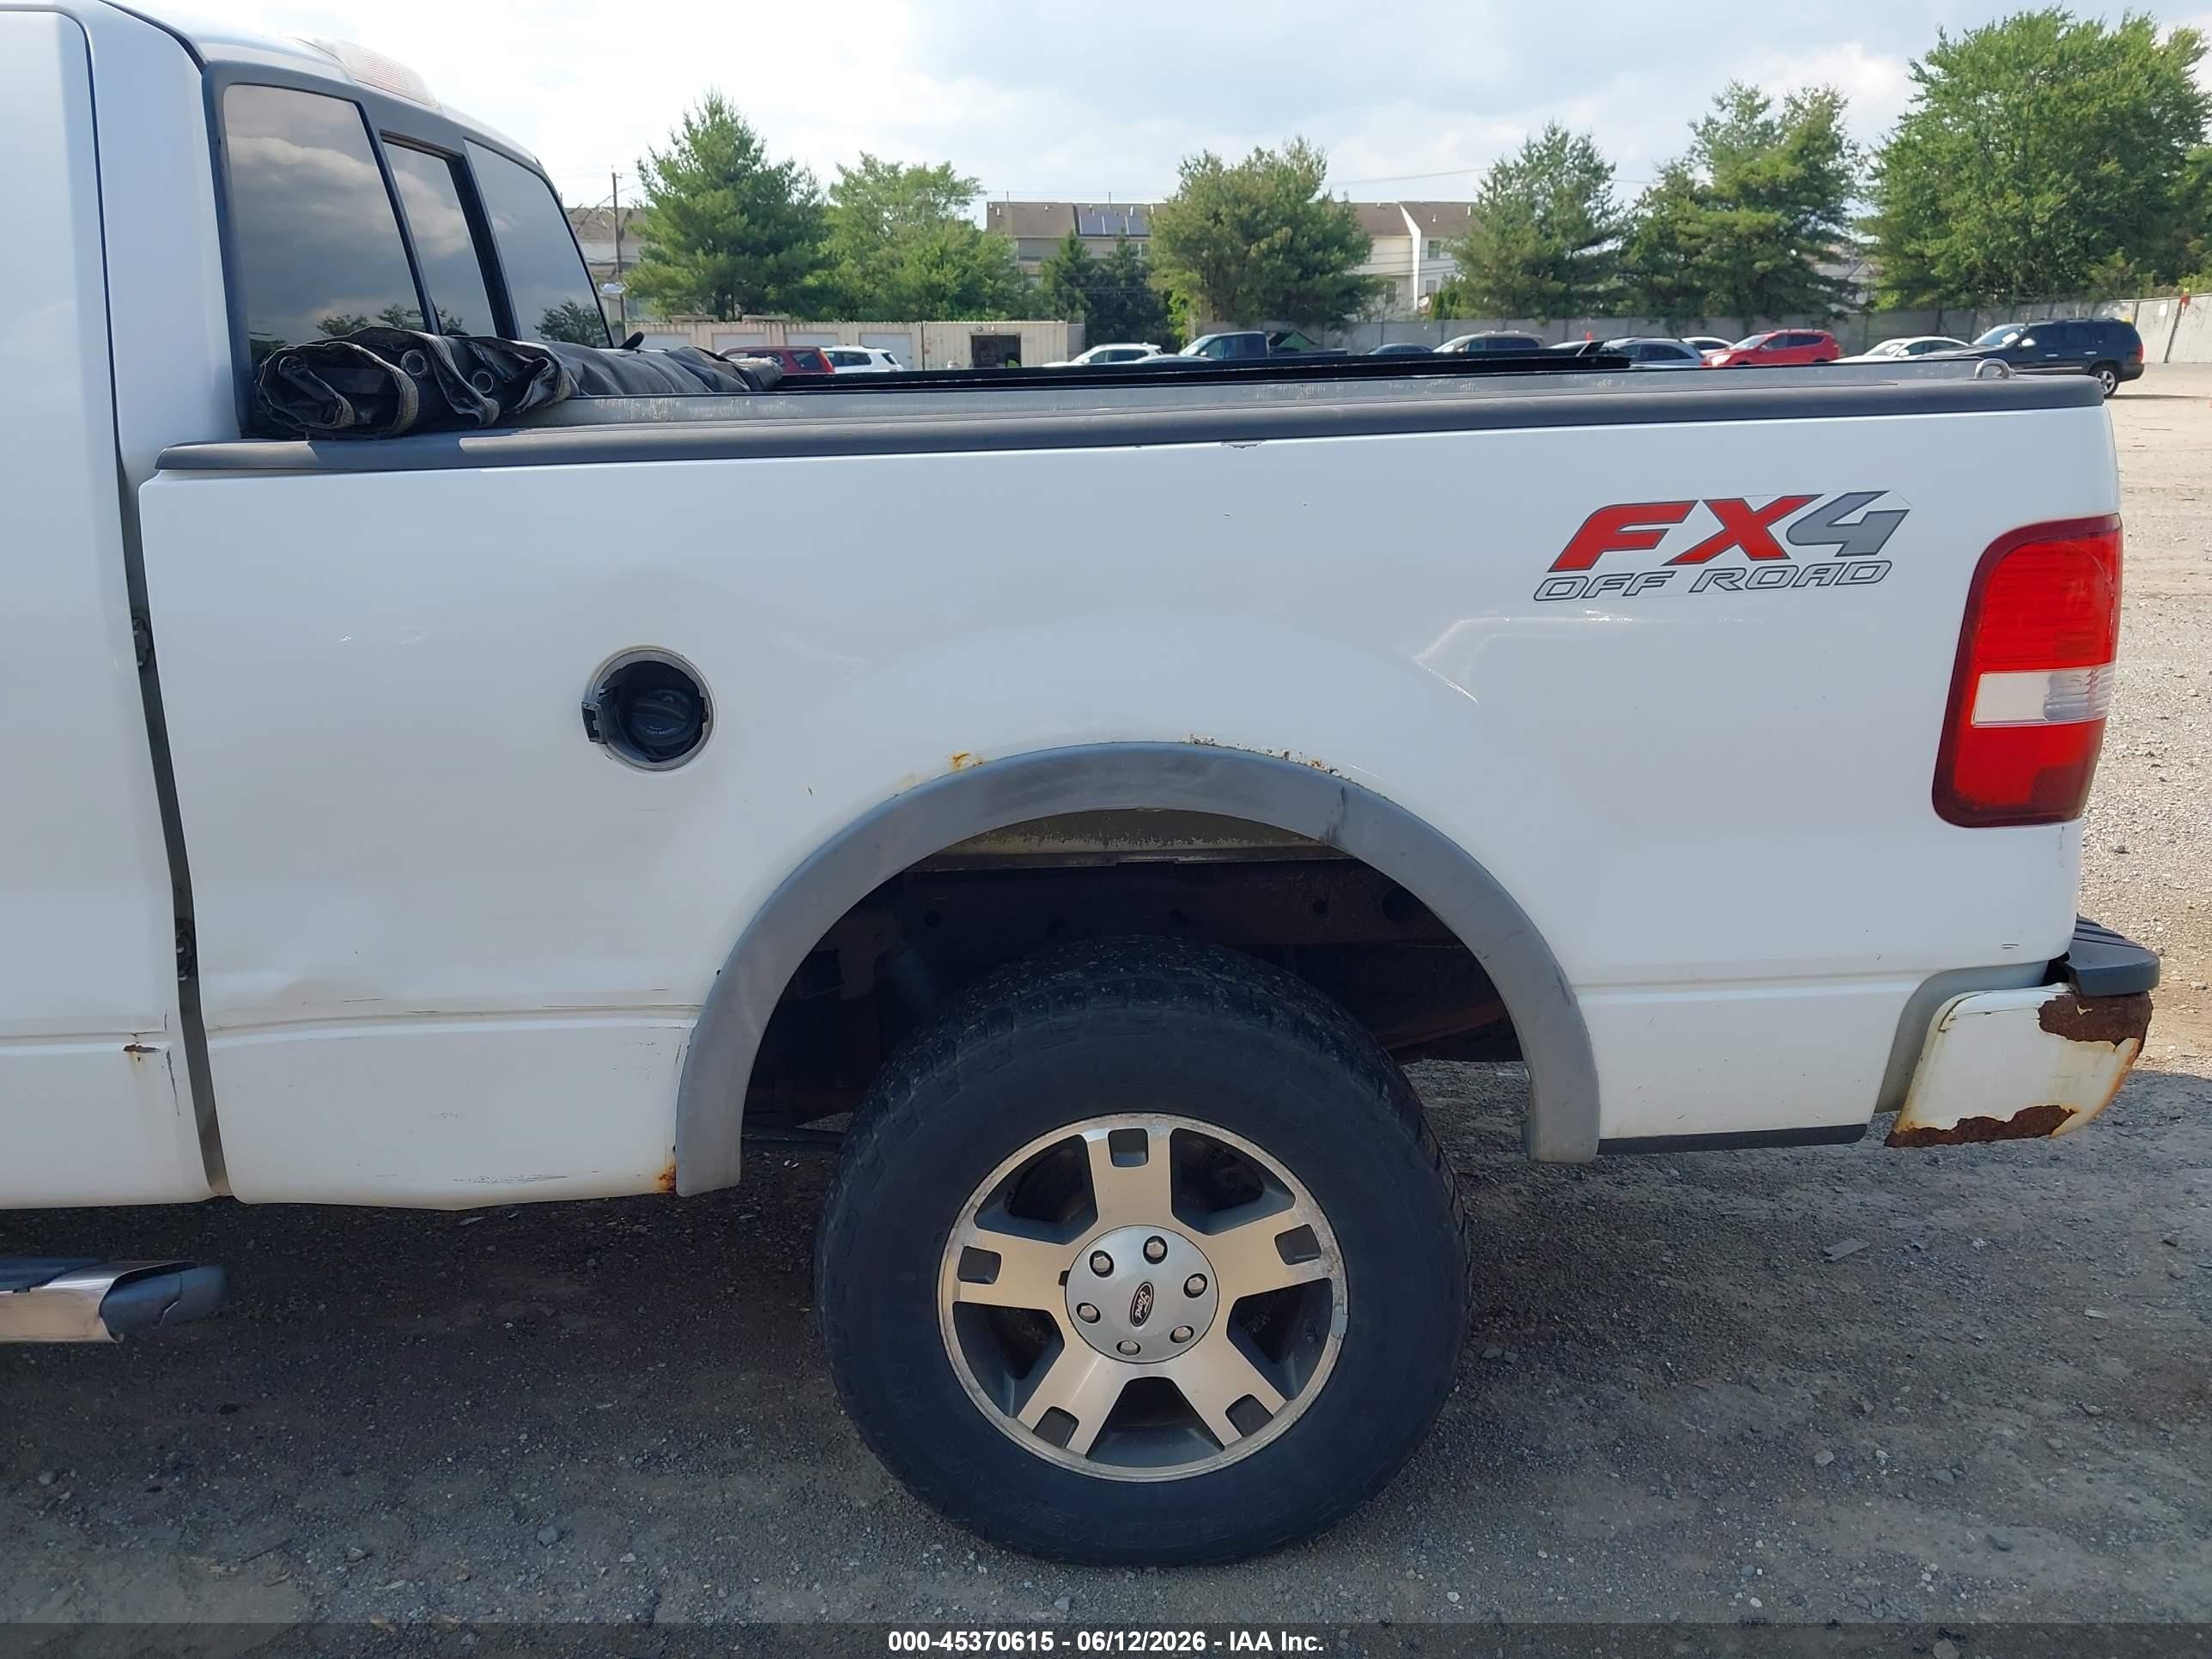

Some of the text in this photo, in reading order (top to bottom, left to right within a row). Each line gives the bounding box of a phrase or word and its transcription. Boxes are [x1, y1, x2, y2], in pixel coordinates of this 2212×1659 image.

[1546, 490, 1911, 574] FX4
[1534, 560, 1893, 602] OFF ROAD
[1133, 1289, 1152, 1321] Ford
